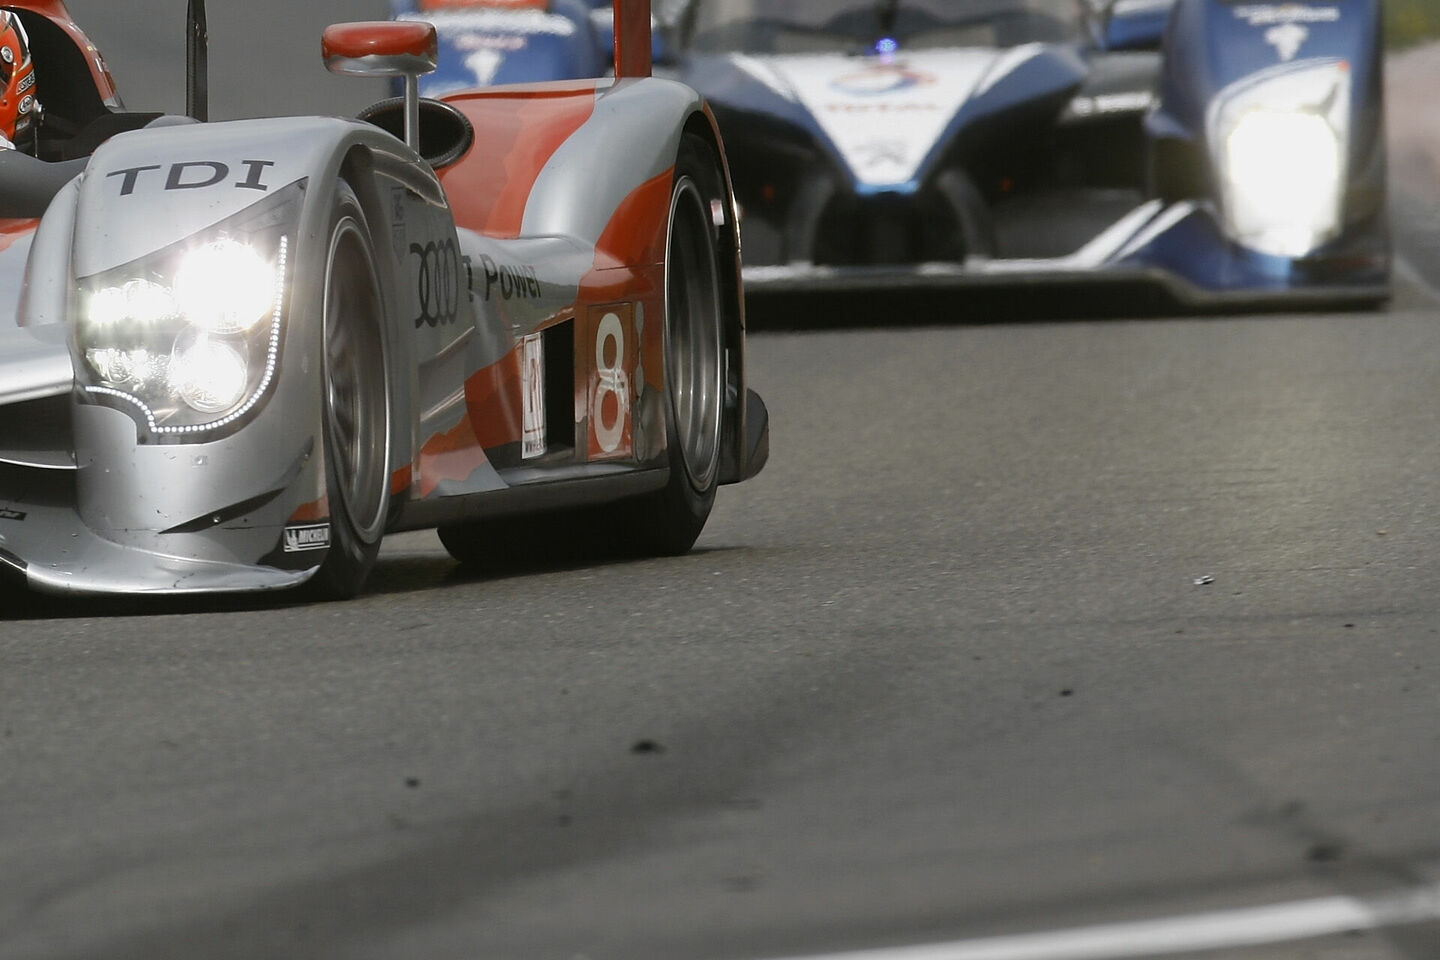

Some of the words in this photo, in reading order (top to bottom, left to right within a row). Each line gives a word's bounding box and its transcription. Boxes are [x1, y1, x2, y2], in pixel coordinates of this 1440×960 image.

[106, 160, 274, 196] TDI
[479, 253, 541, 301] Power
[594, 312, 626, 452] 8
